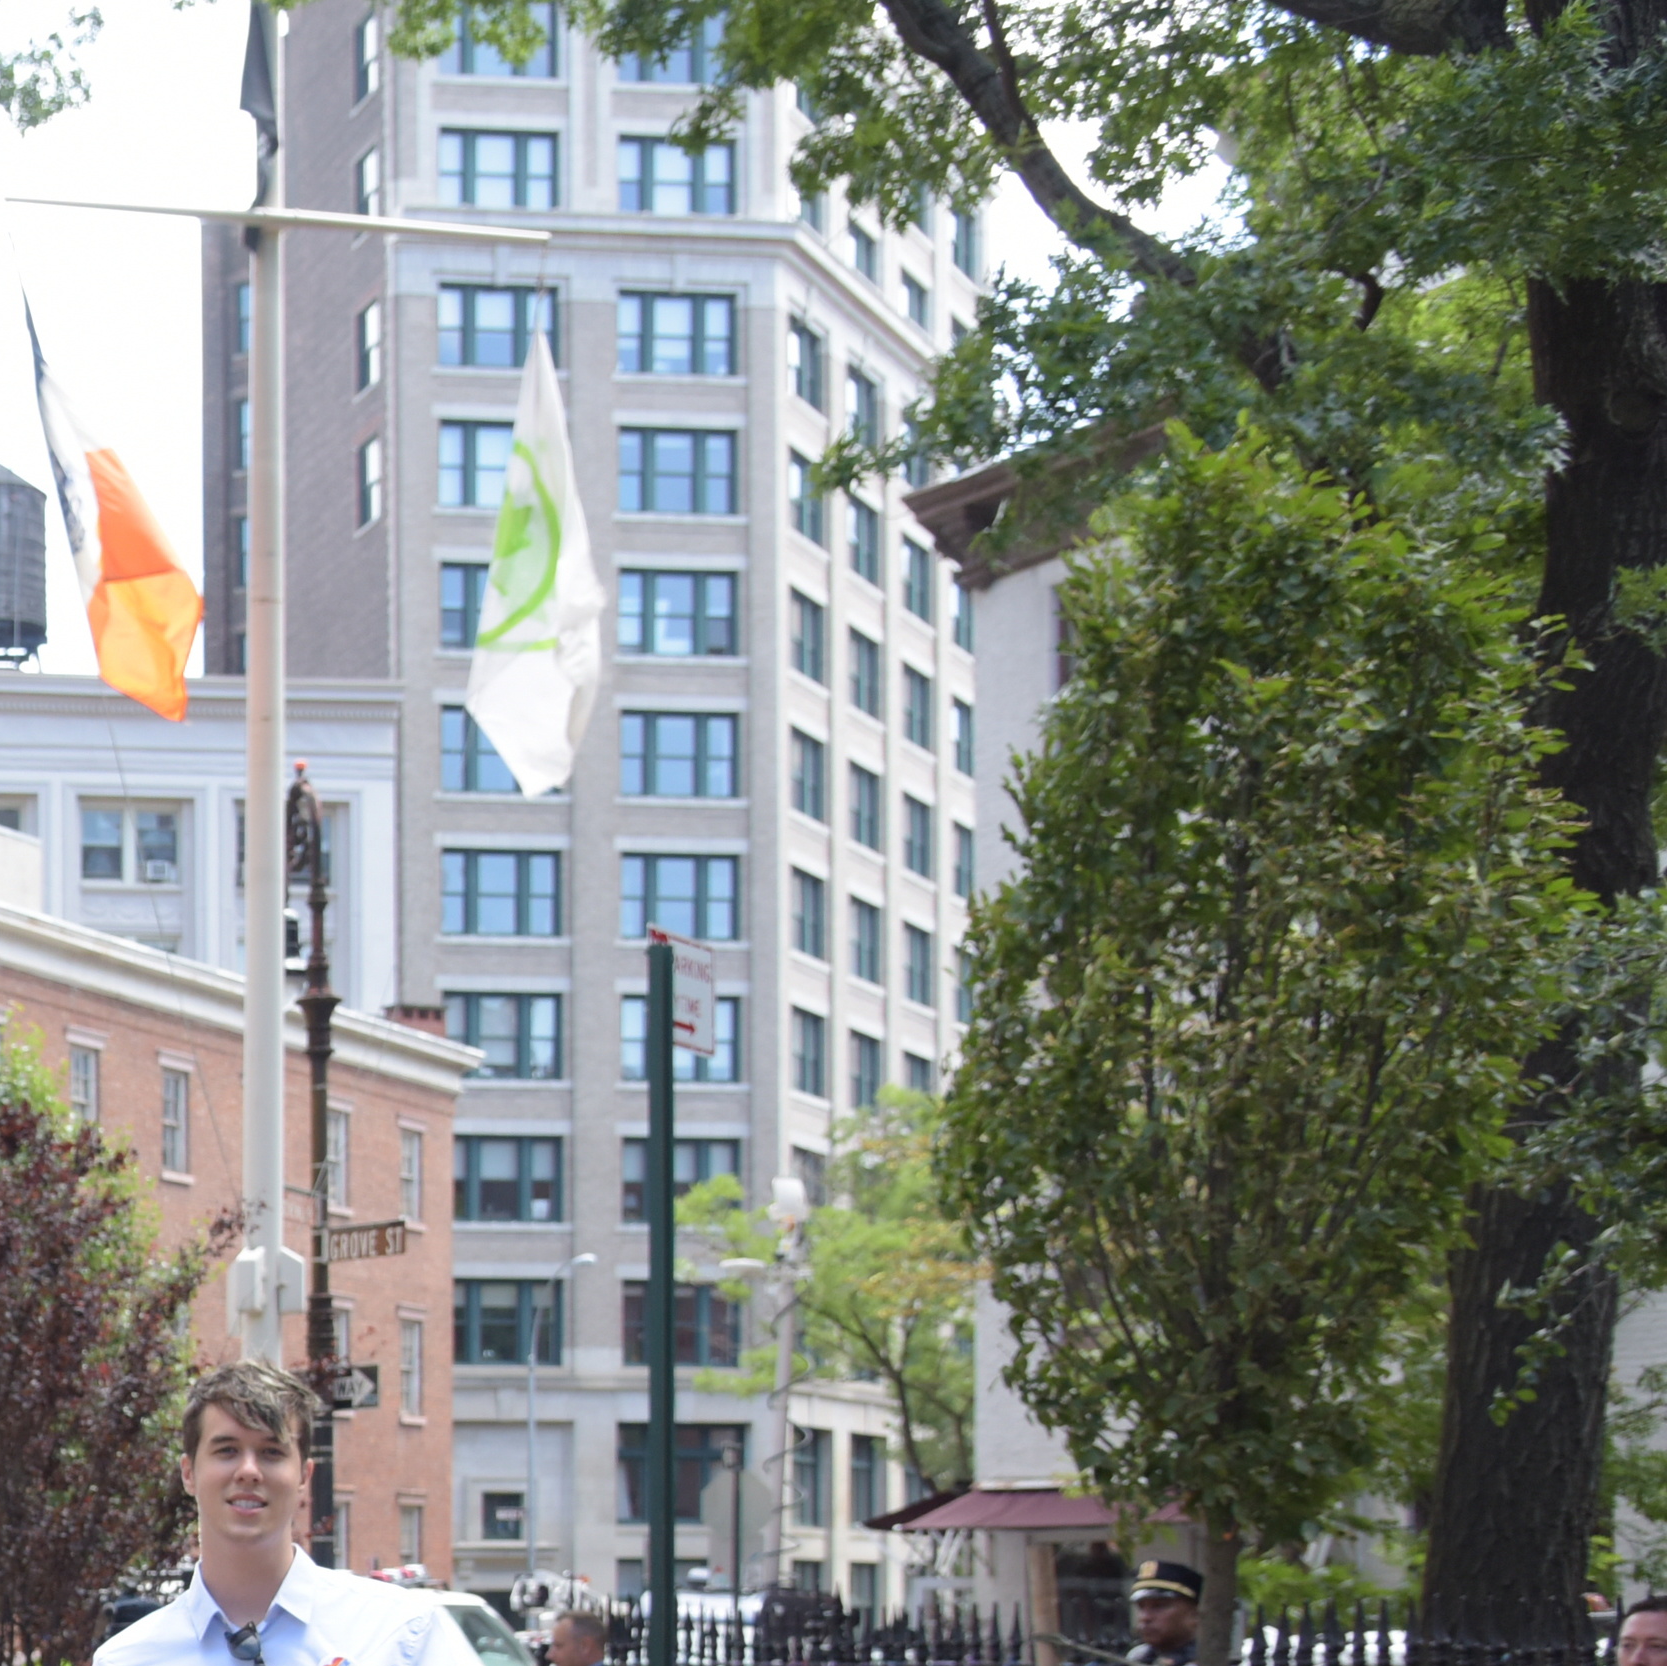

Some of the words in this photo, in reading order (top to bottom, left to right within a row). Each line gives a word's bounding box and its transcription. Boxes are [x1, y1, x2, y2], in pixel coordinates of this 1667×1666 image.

[673, 954, 711, 983] ARKING
[330, 1230, 378, 1261] GROVE
[385, 1226, 404, 1255] ST
